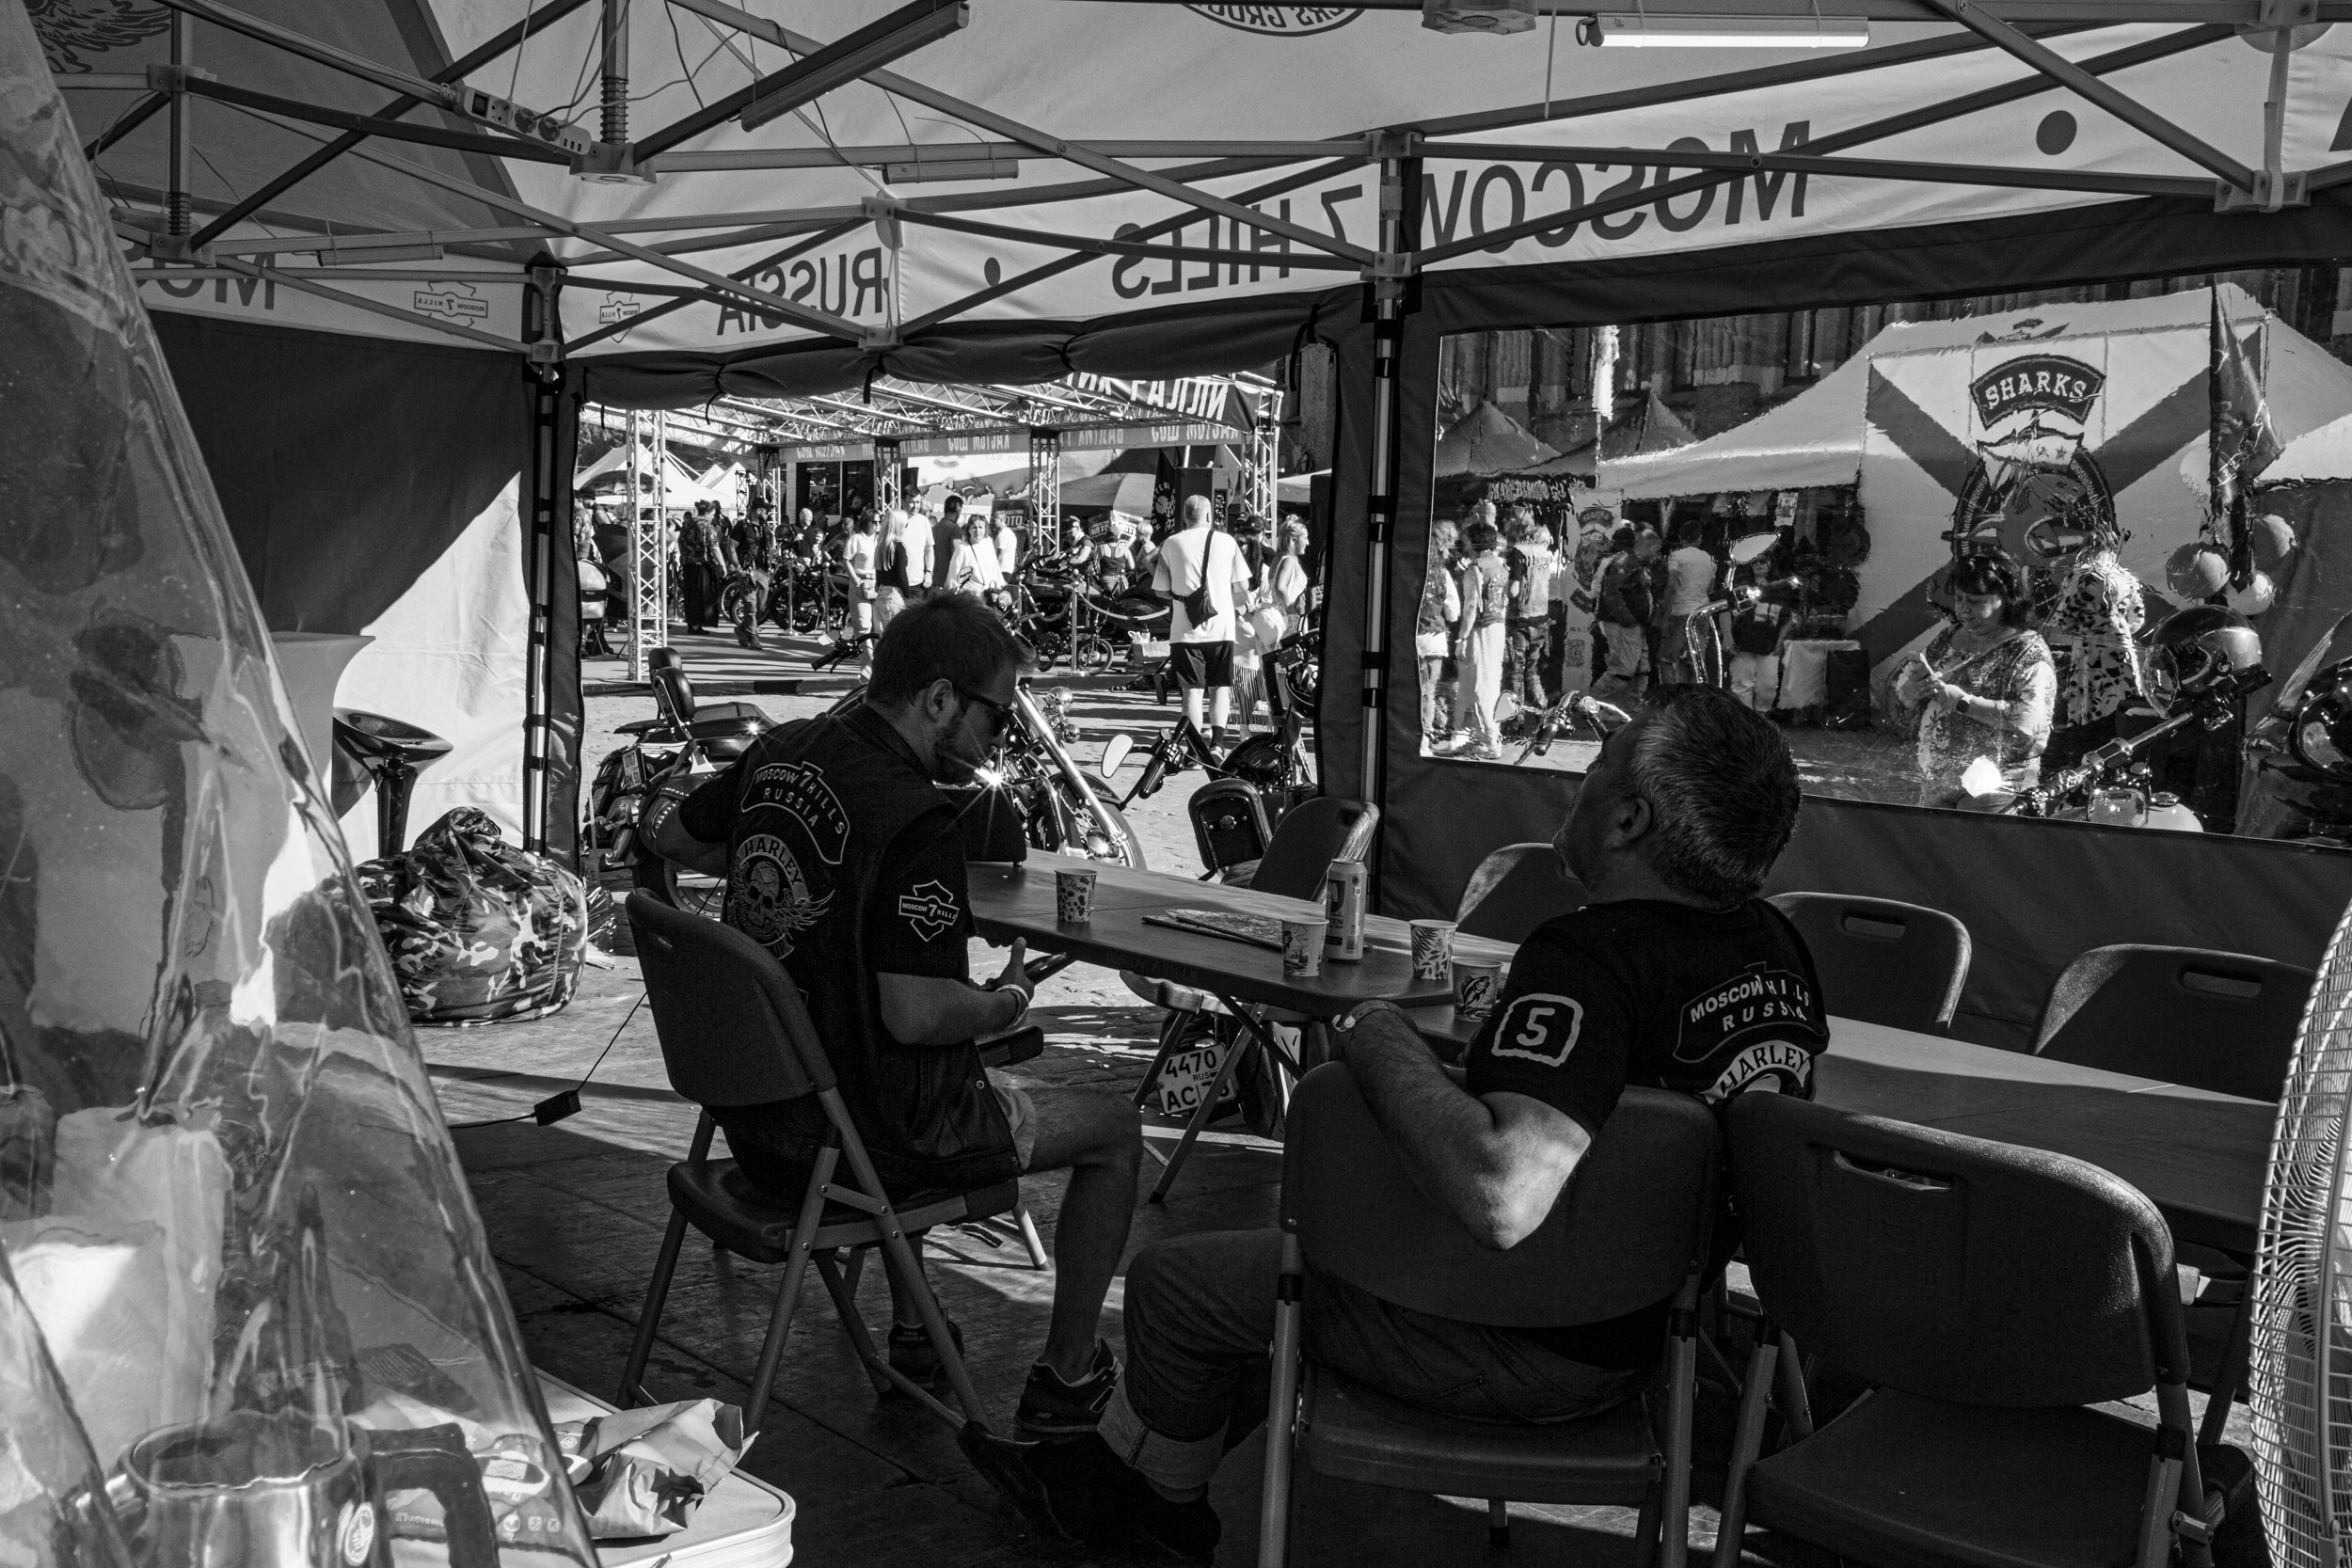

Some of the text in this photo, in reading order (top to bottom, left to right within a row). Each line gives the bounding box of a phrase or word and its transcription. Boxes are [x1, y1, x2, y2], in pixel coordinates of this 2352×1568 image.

[1984, 371, 2088, 410] SHARKS
[755, 768, 845, 835] MOSCOW 7 HILLS
[763, 787, 819, 828] RUSSIA
[743, 836, 803, 884] HARLEY
[901, 902, 928, 912] MOSCOW
[928, 903, 937, 917] 7
[1690, 978, 1764, 1023] MOSCOW
[1722, 1001, 1807, 1032] RUSSIA
[1516, 1007, 1555, 1047] 5
[1165, 1050, 1216, 1078] 4470
[1192, 1071, 1210, 1082] RUS
[1720, 1044, 1810, 1095] HARLEY
